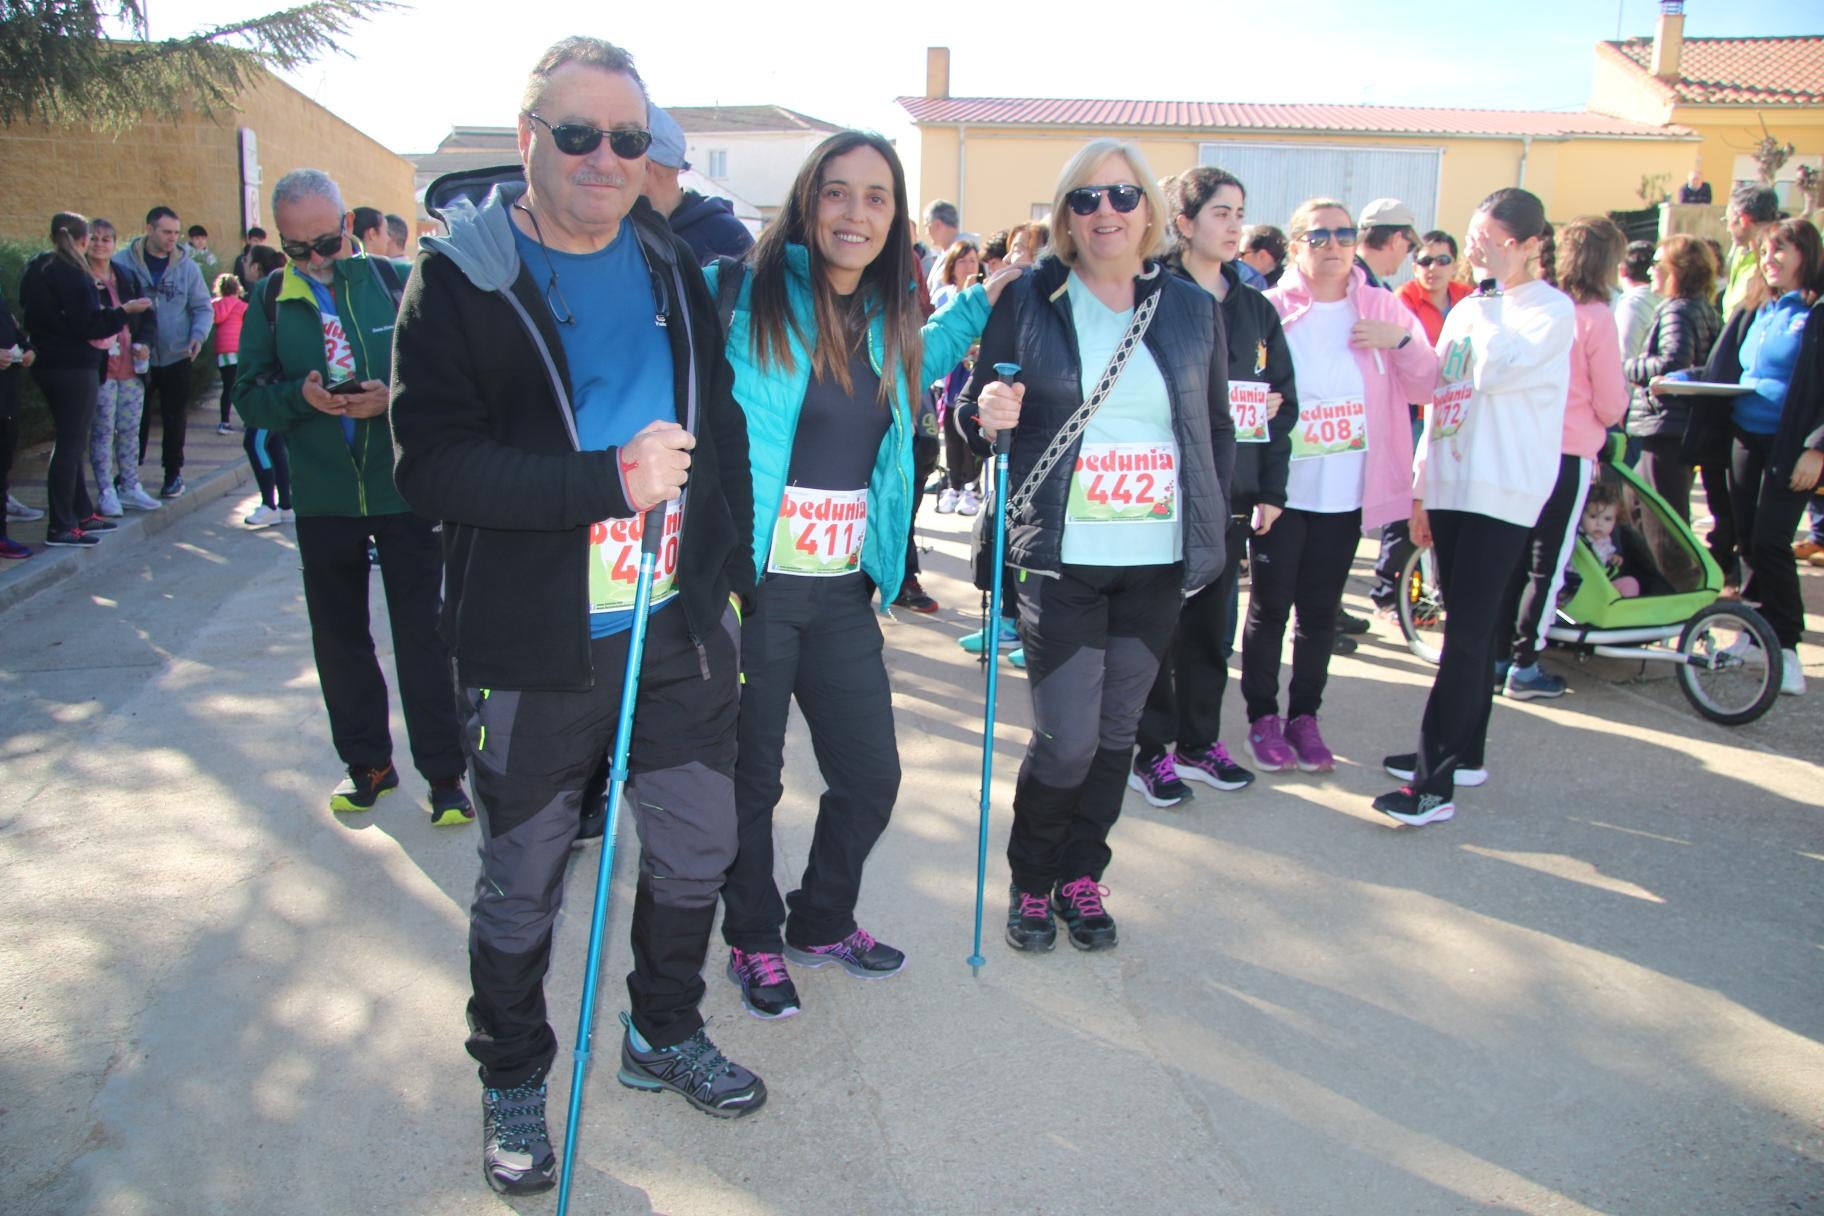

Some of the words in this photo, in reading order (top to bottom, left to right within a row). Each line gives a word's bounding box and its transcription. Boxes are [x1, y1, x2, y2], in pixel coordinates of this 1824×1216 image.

[325, 339, 352, 369] 32
[1230, 387, 1266, 403] dunia
[1230, 404, 1257, 427] 73
[1300, 401, 1364, 421] edunia
[1304, 418, 1352, 444] 408
[1087, 473, 1154, 504] 442
[780, 494, 866, 521] bedunia
[590, 505, 682, 544] bedni
[796, 523, 853, 556] 411
